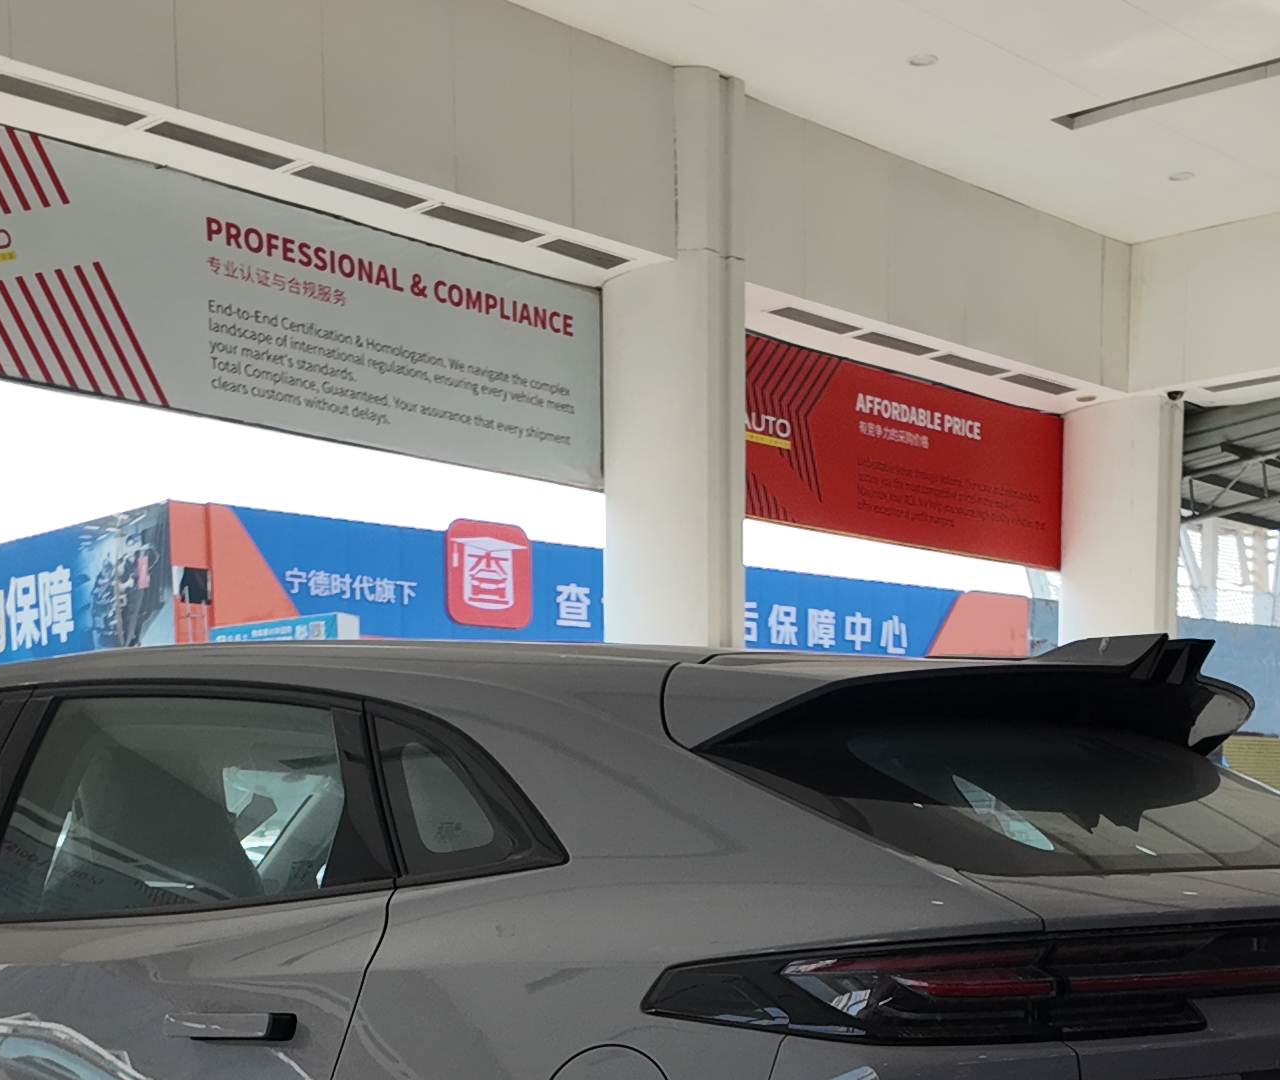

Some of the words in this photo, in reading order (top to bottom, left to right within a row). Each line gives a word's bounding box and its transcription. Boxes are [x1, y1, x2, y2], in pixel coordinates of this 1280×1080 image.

[206, 216, 405, 293] PROFESSIONAL
[410, 273, 429, 299] &
[433, 280, 575, 337] COMPLIANCE
[206, 256, 348, 308] 专业认证与合规服务
[207, 299, 278, 328] End-to-End
[281, 317, 353, 345] Certification
[355, 335, 364, 348] &
[448, 357, 465, 372] We
[467, 365, 510, 383] navigate
[511, 373, 528, 387] the
[529, 380, 571, 397] complex
[208, 318, 273, 345] landscape
[275, 335, 288, 348] of
[290, 337, 366, 366] international
[433, 374, 480, 396] ensuring
[480, 384, 508, 403] every
[510, 390, 545, 408] vehicle
[546, 399, 576, 414] meets
[209, 340, 239, 355] your
[210, 356, 242, 376] Total
[393, 395, 418, 413] Your
[420, 404, 472, 425] assurance
[474, 414, 496, 431] that
[496, 421, 524, 438] every
[211, 376, 249, 395] clears
[250, 386, 303, 407] customs
[304, 396, 351, 417] without
[855, 392, 942, 432] AFFORDABLE
[943, 413, 982, 441] PRICE
[285, 567, 418, 606] 宁德时代旗下
